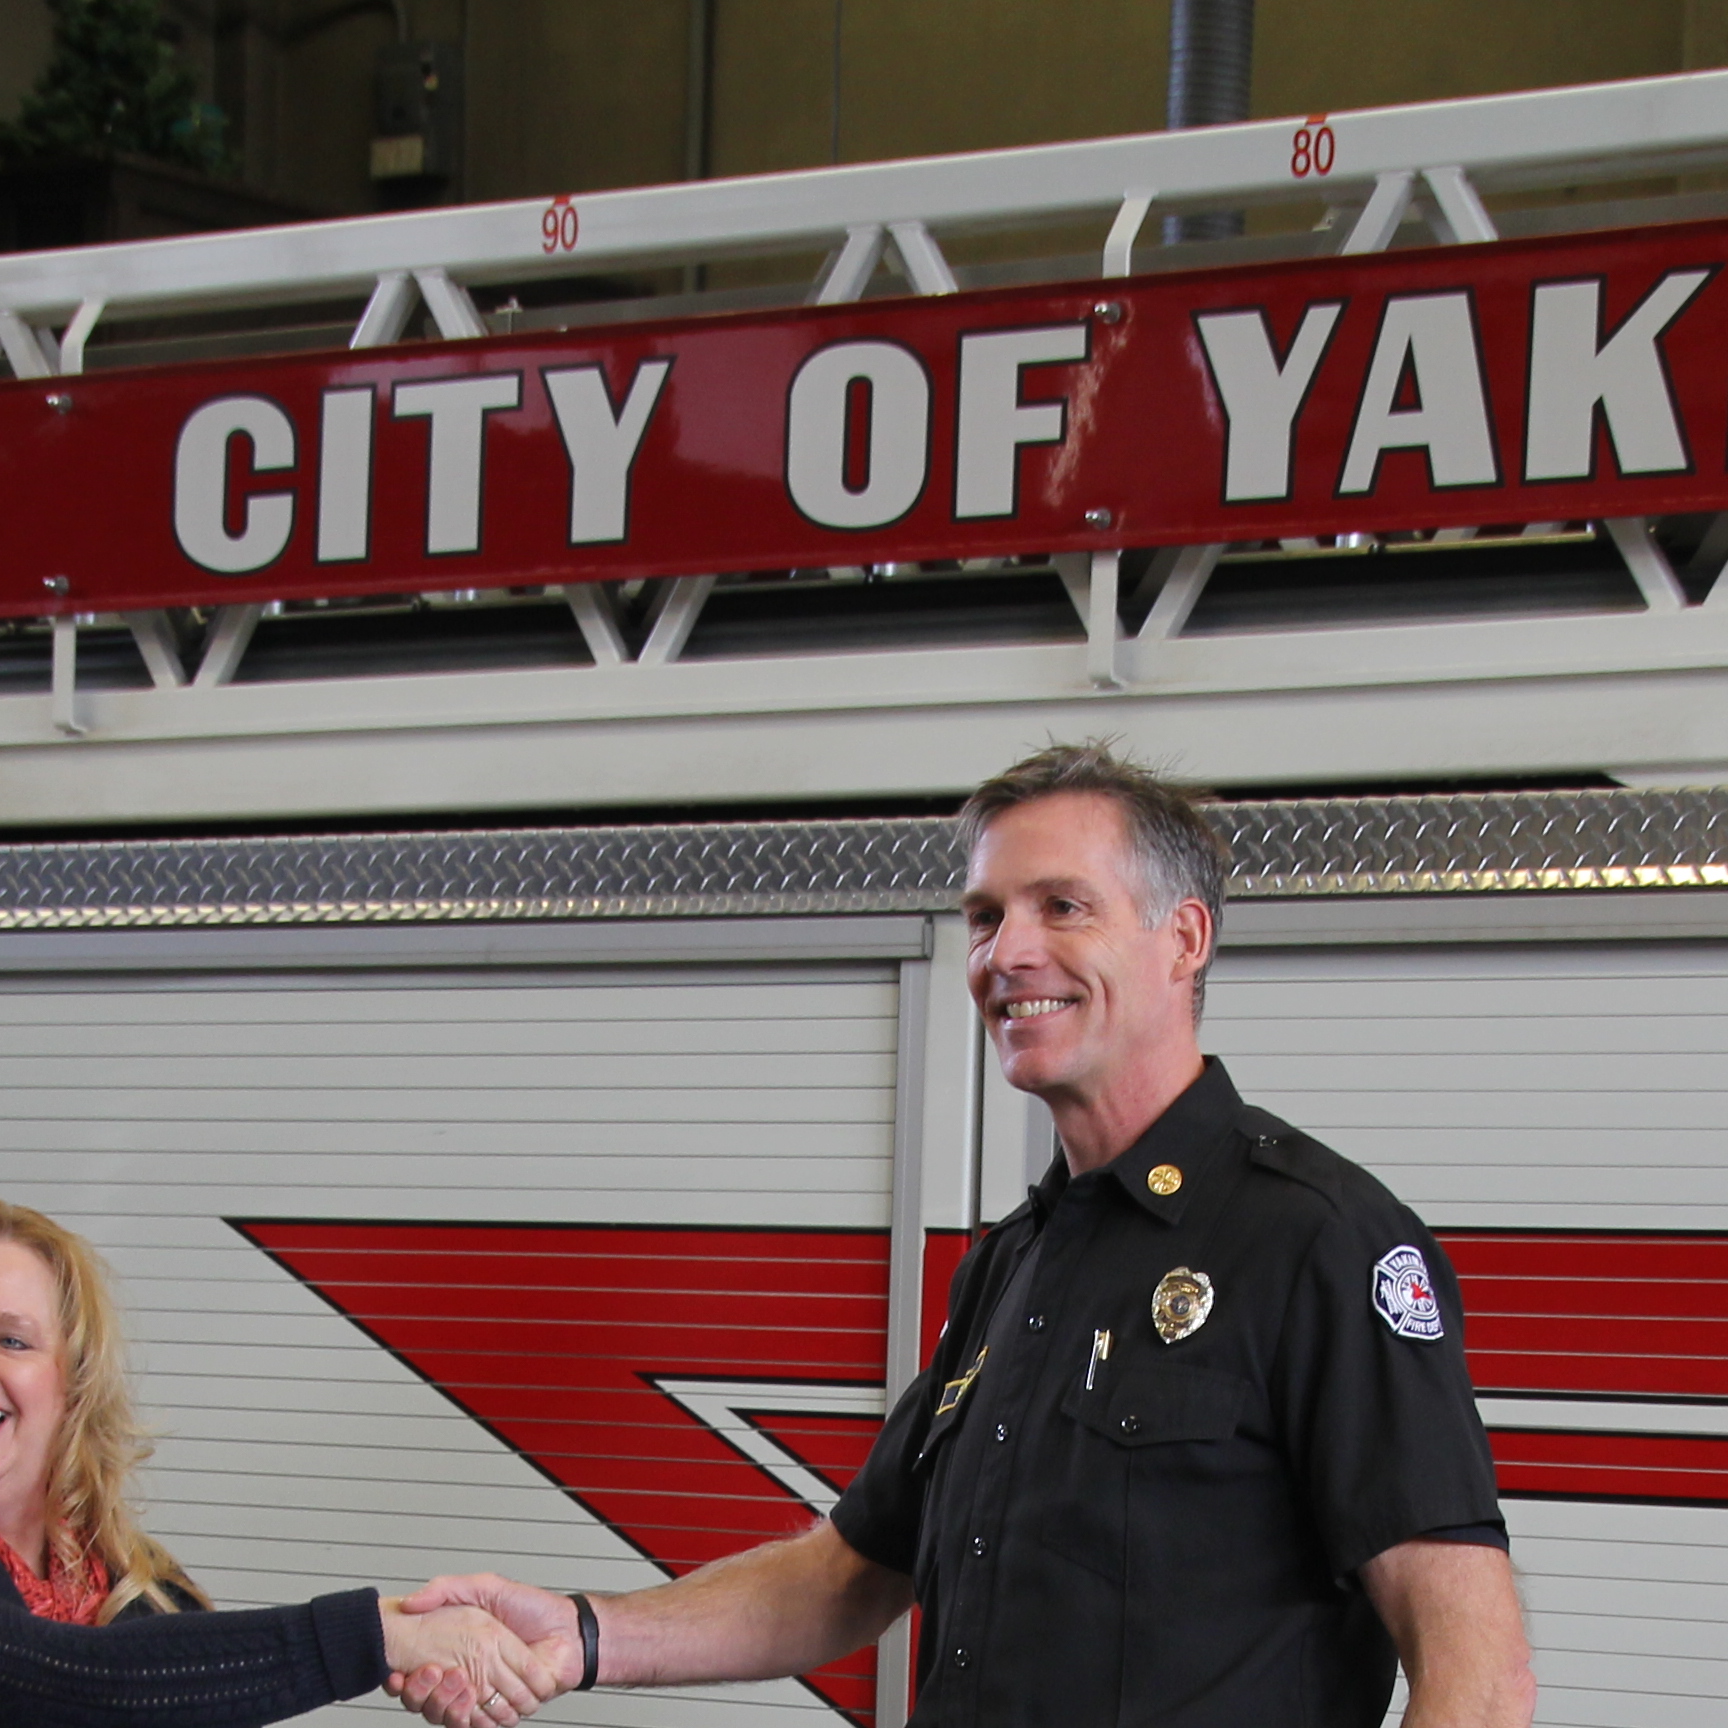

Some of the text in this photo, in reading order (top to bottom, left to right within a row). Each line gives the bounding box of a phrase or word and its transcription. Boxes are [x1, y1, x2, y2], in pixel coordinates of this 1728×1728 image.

[1291, 127, 1335, 178] 80
[542, 208, 579, 255] 90
[171, 356, 674, 574] CITY
[784, 319, 1093, 531] OF
